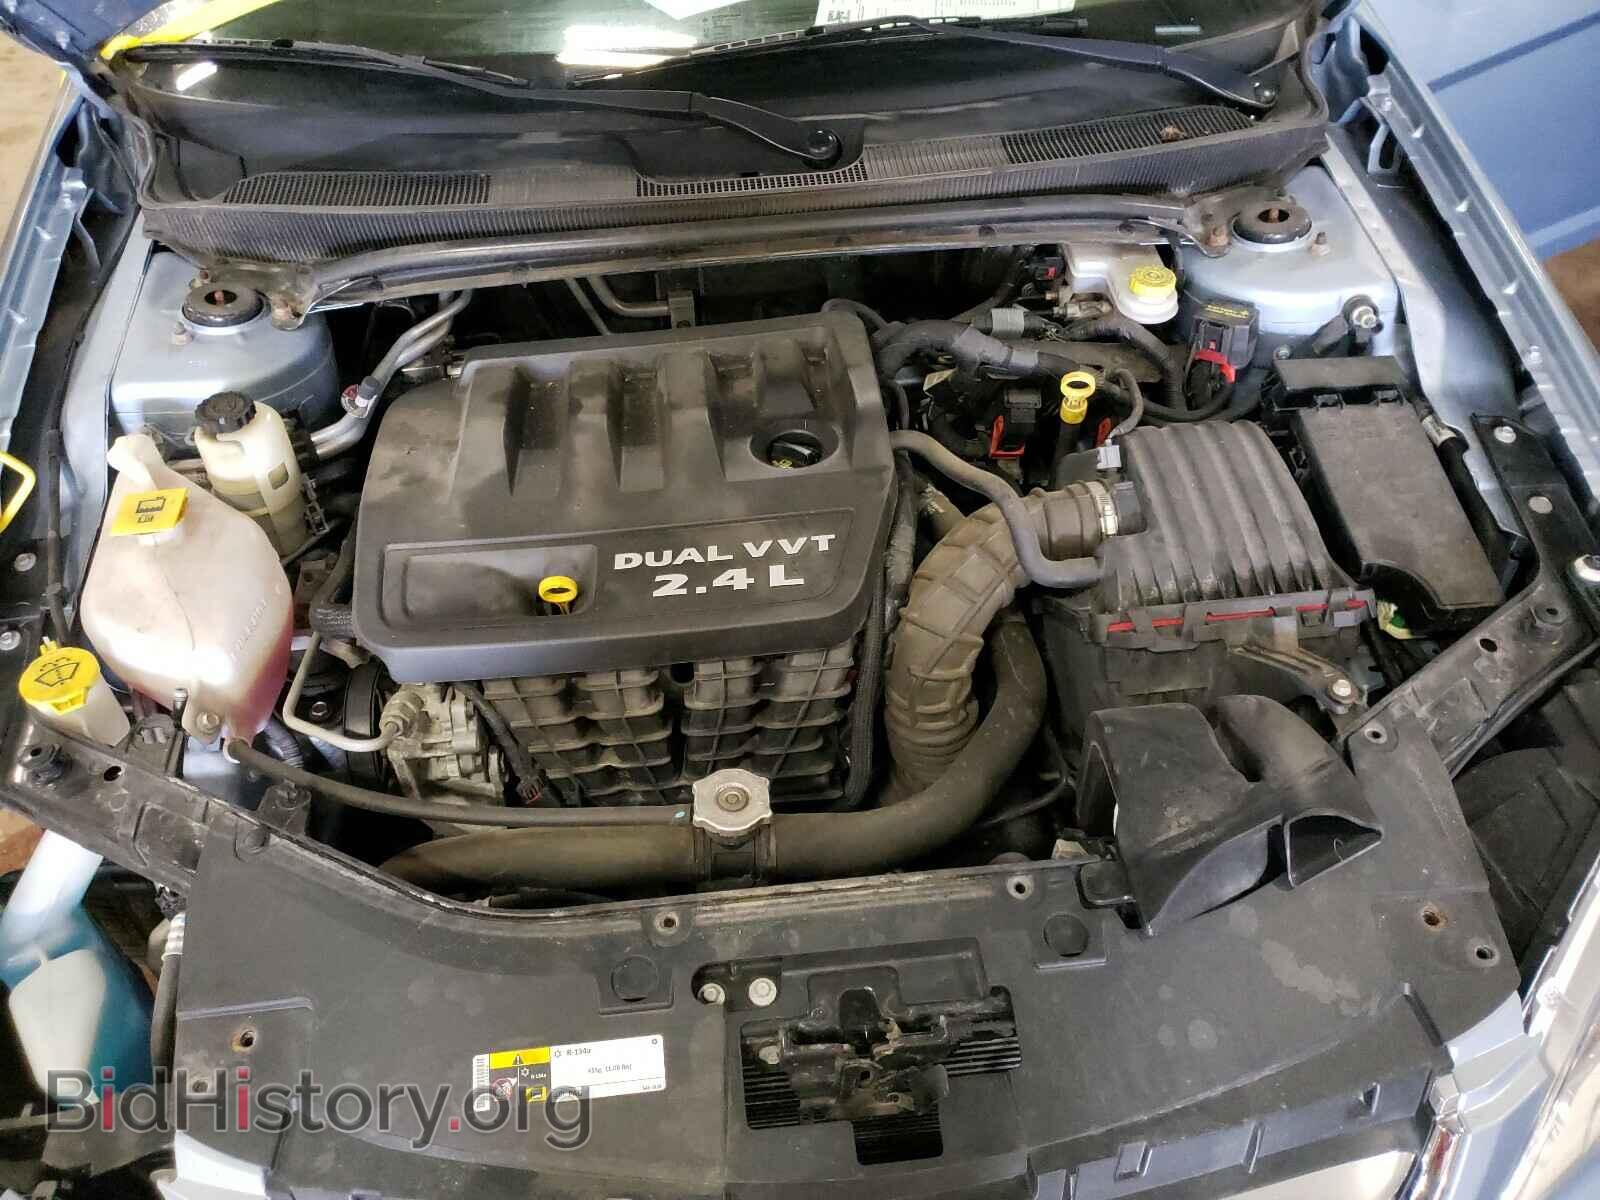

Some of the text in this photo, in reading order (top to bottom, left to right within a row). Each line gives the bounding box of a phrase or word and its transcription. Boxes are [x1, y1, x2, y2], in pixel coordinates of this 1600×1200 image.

[614, 534, 836, 570] DUAL VVT
[652, 564, 805, 598] 2.4 L
